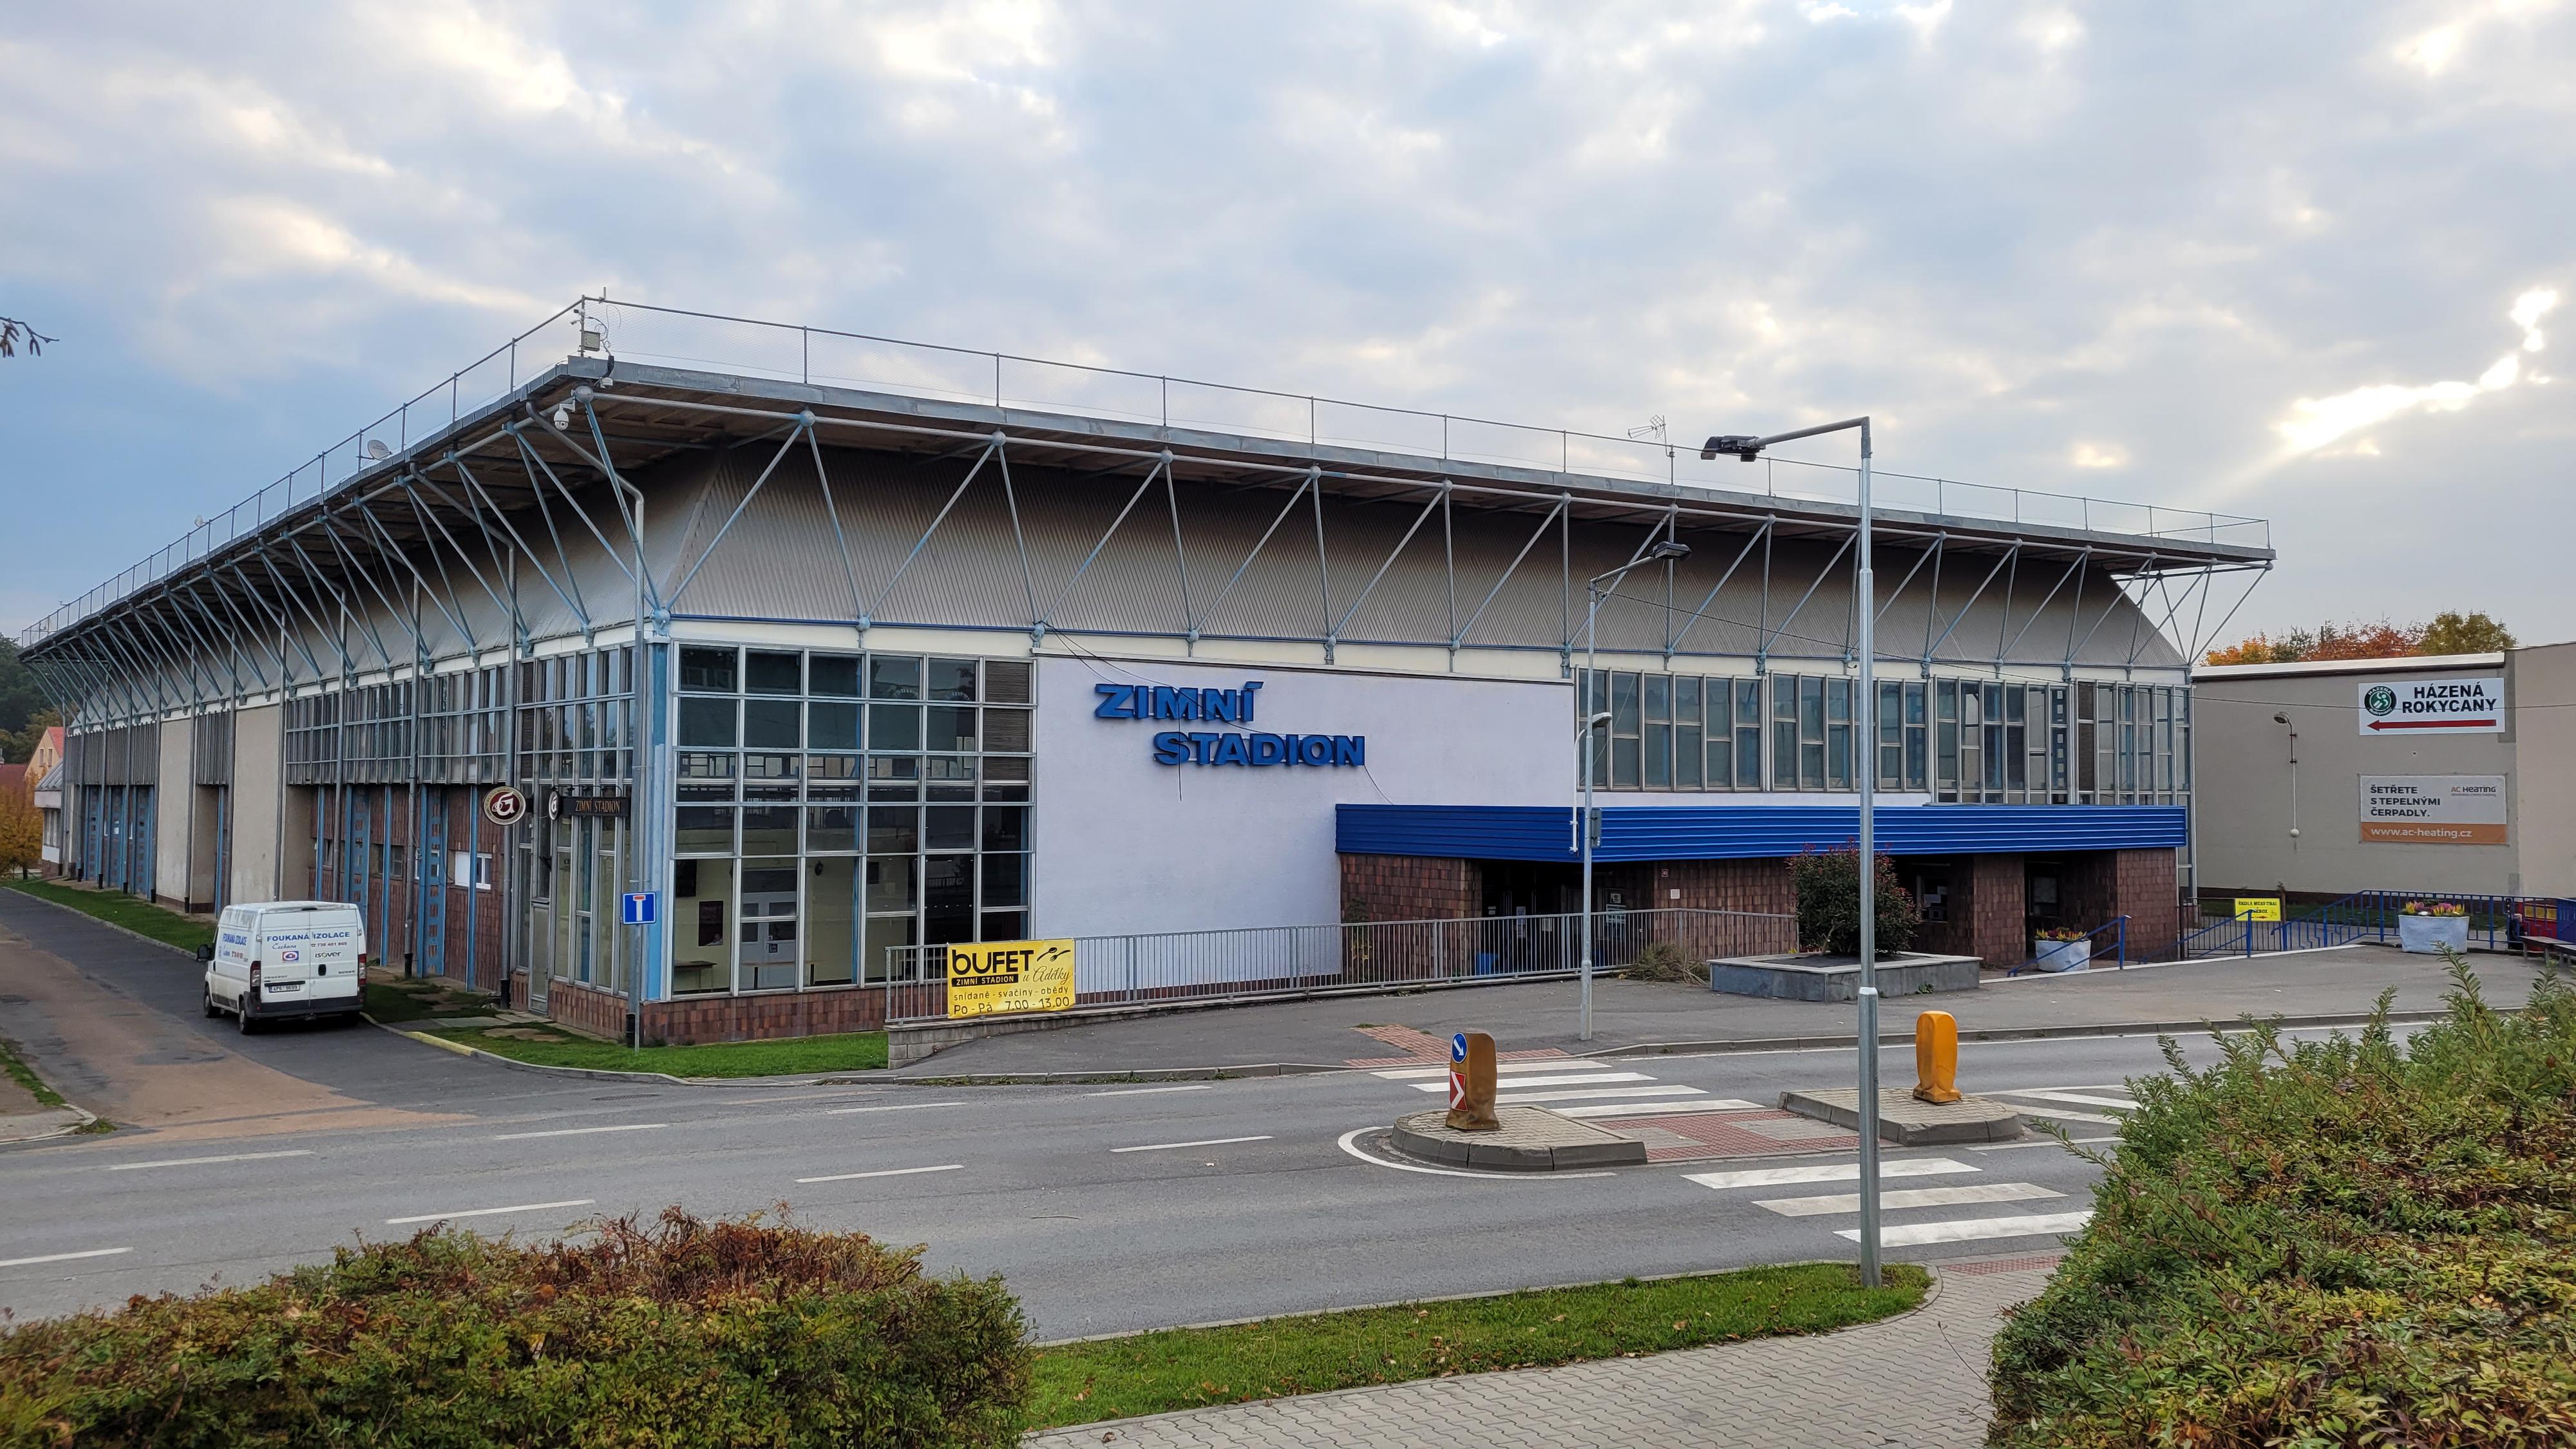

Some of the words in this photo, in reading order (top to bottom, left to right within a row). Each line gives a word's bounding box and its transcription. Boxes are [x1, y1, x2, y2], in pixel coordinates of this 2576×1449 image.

[2414, 681, 2484, 699] HÁZENÁ
[1095, 681, 1264, 722] ZIMNÍ
[2402, 699, 2497, 714] ROKYCANY
[1153, 732, 1365, 766] STADION
[2370, 784, 2418, 794] ŠETŘETE
[575, 799, 592, 812] ZIMNÍ
[594, 800, 620, 813] STADION
[2379, 796, 2441, 806] TEPELNÝMI
[2371, 807, 2430, 817] ČERPADLY.
[2371, 828, 2472, 838] www.ac-heating.cz
[267, 933, 310, 942] FOUKANÁ
[956, 978, 978, 986] ZIMNÍ
[981, 976, 1014, 984] STADION
[954, 992, 990, 1001] snídaně
[998, 989, 1033, 998] svačiny
[1041, 986, 1068, 995] obědy
[954, 1005, 968, 1015] Po
[978, 1002, 992, 1013] Pá
[1005, 999, 1029, 1010] 7.00
[1038, 996, 1070, 1009] 13.00
